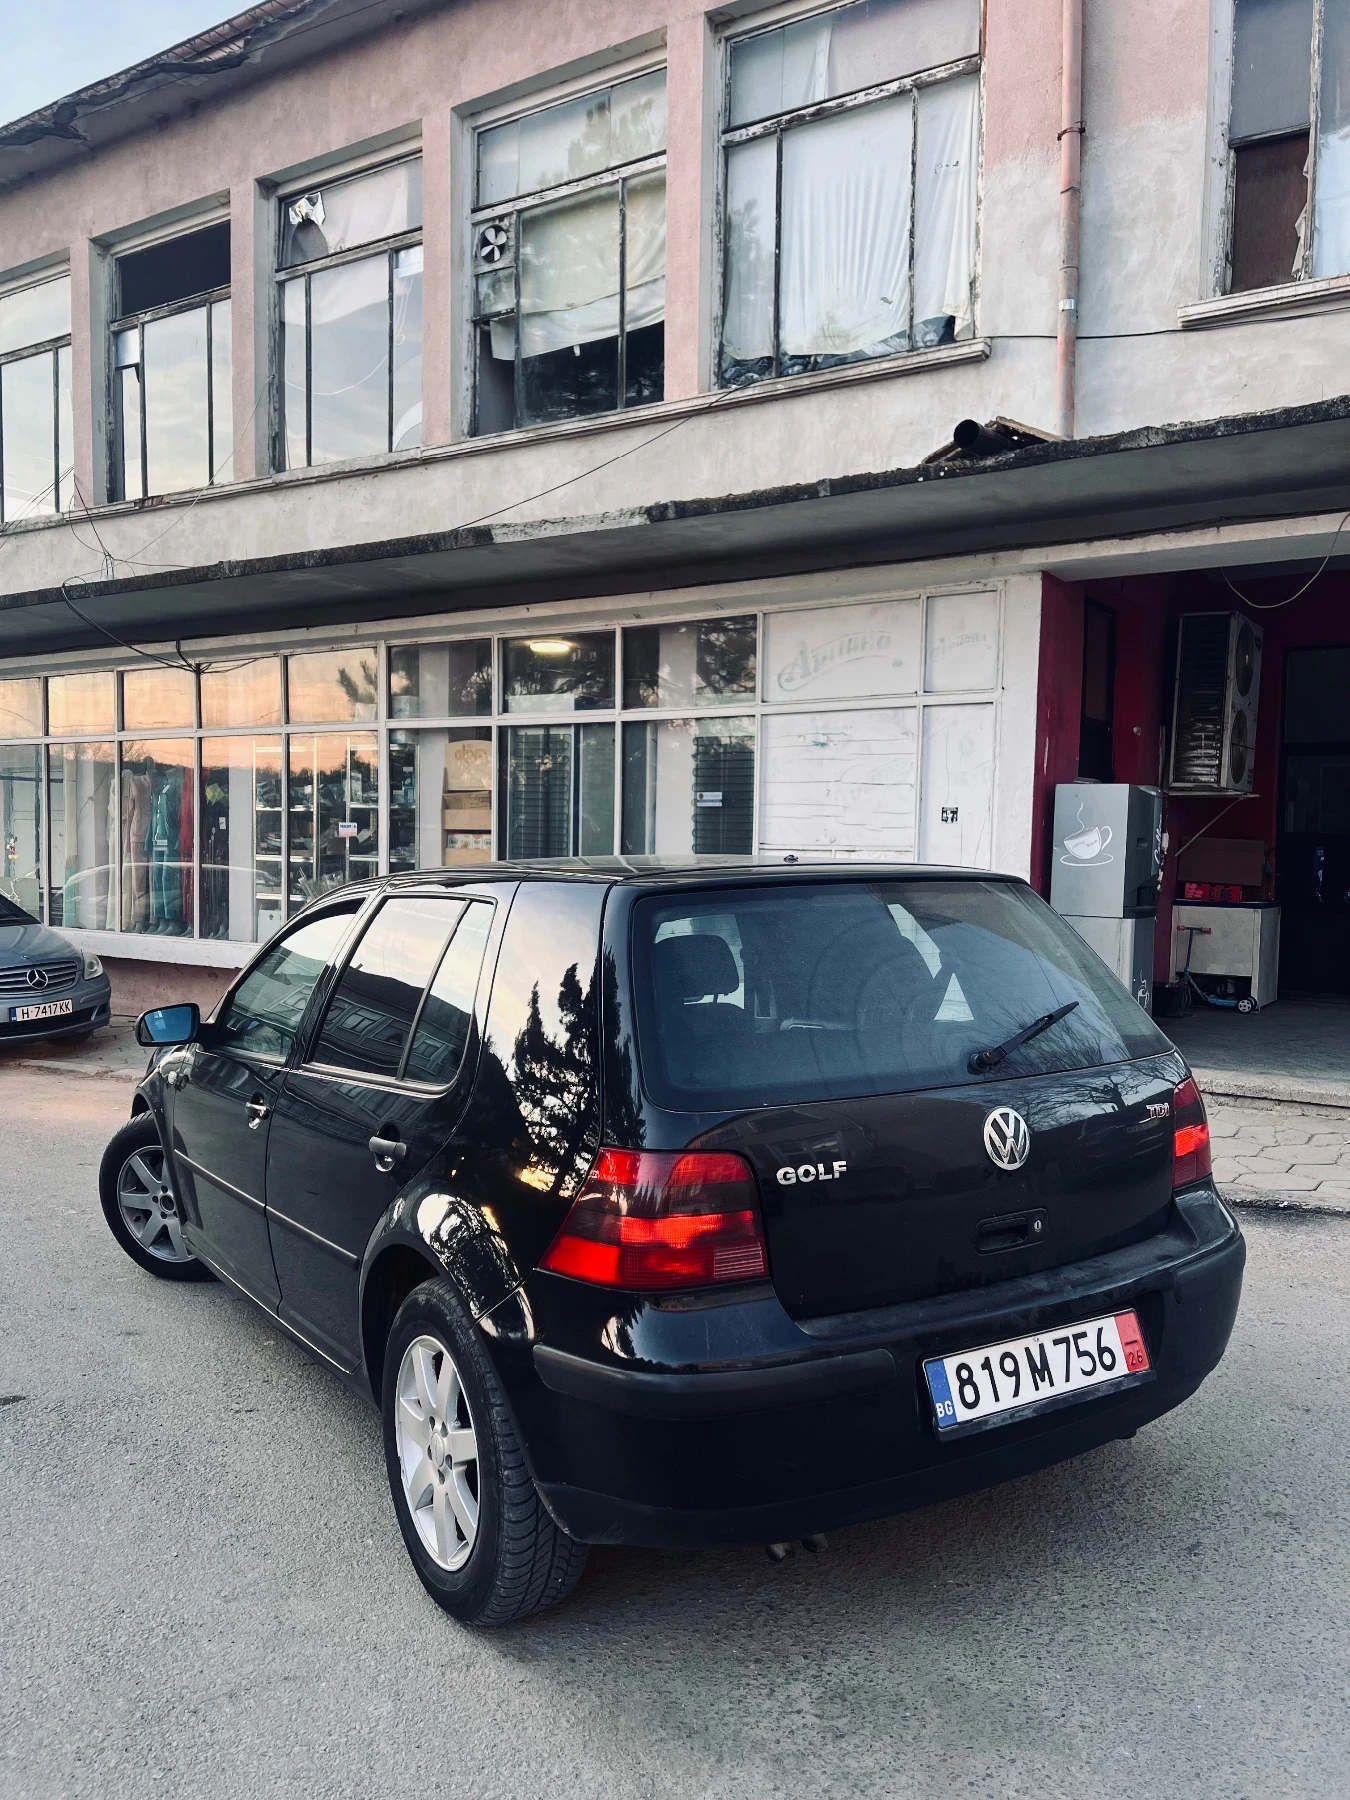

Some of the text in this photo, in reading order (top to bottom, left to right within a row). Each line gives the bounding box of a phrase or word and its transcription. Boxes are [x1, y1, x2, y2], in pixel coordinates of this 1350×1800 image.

[1146, 1102, 1170, 1118] TDI
[776, 1160, 847, 1186] GOLF
[1128, 1349, 1144, 1366] 26
[935, 1402, 954, 1418] BG
